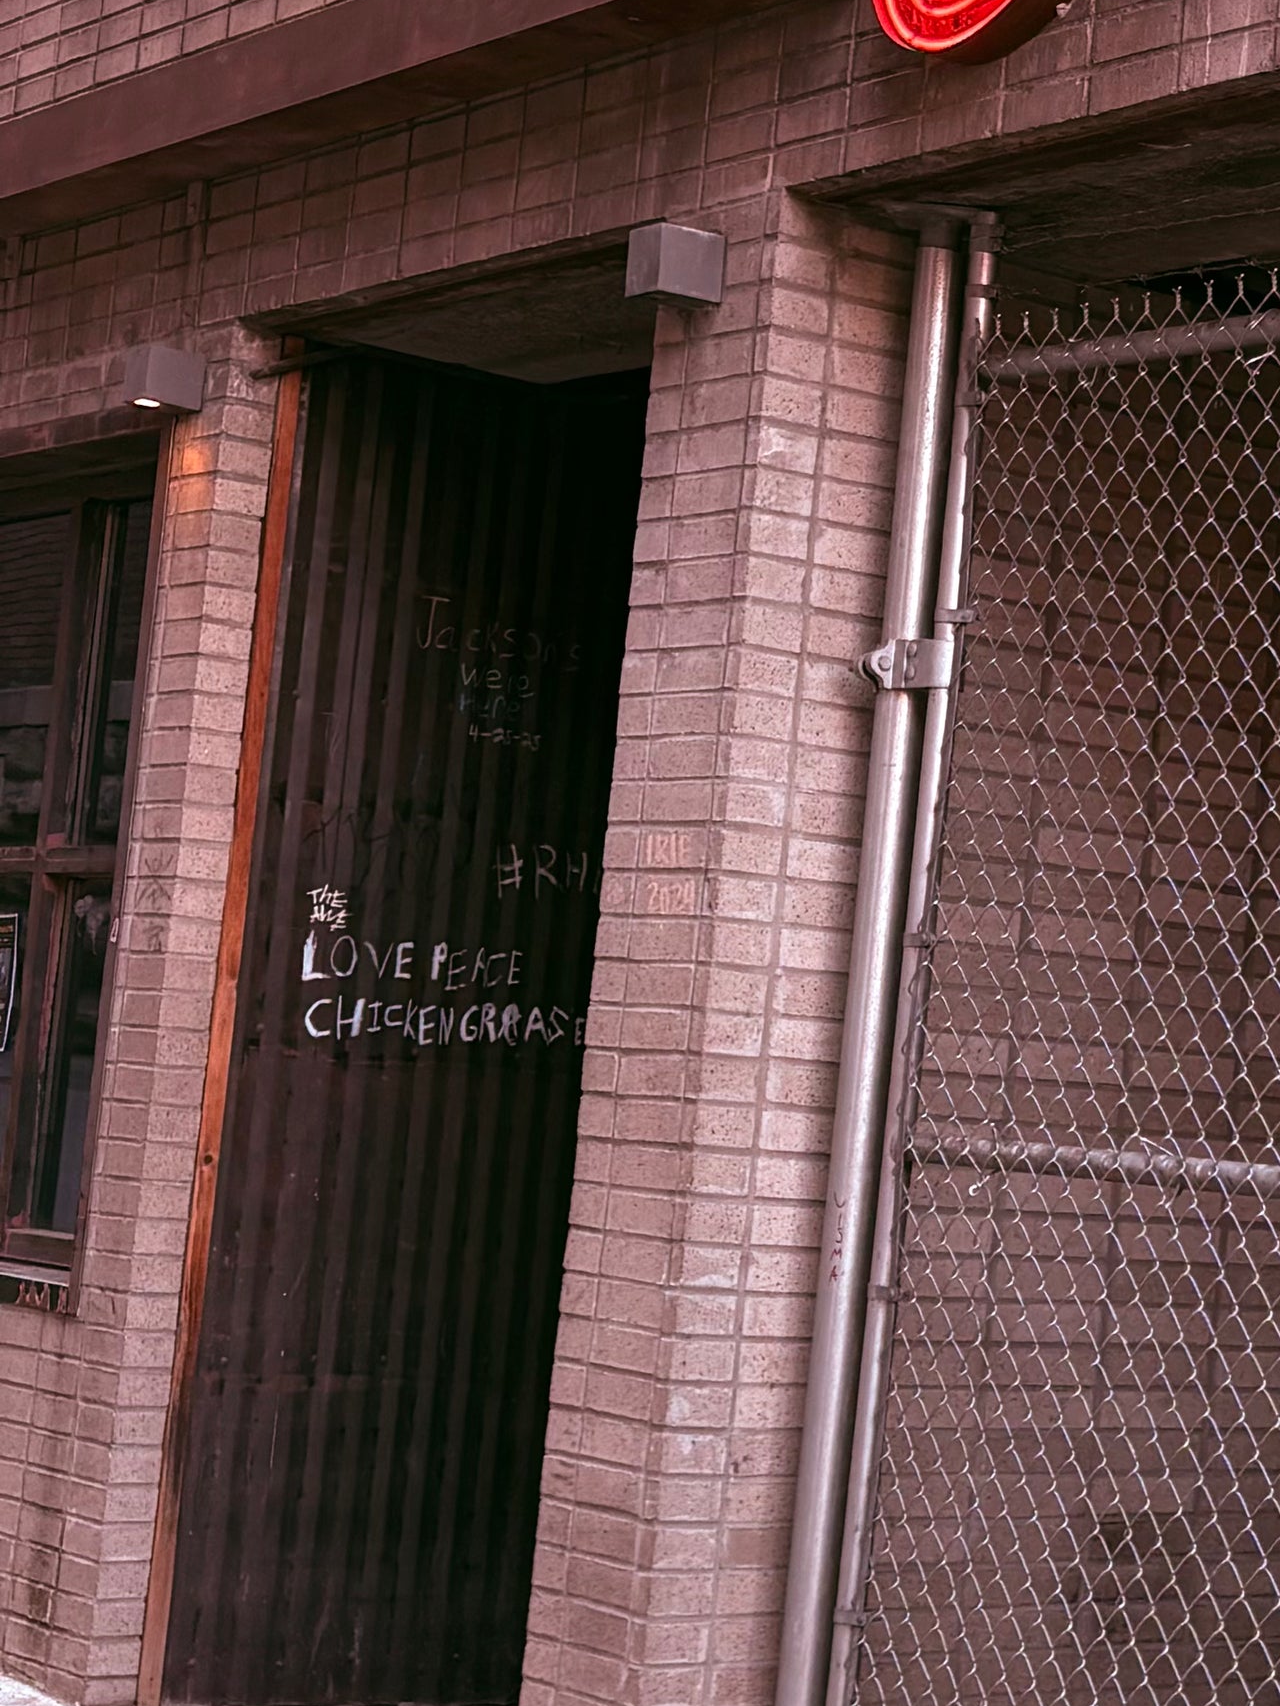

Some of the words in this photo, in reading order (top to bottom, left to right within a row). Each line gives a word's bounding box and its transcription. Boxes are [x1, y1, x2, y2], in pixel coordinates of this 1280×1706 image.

[492, 843, 601, 899] #RH
[301, 930, 414, 981] LOVE
[431, 941, 523, 991] PEACE
